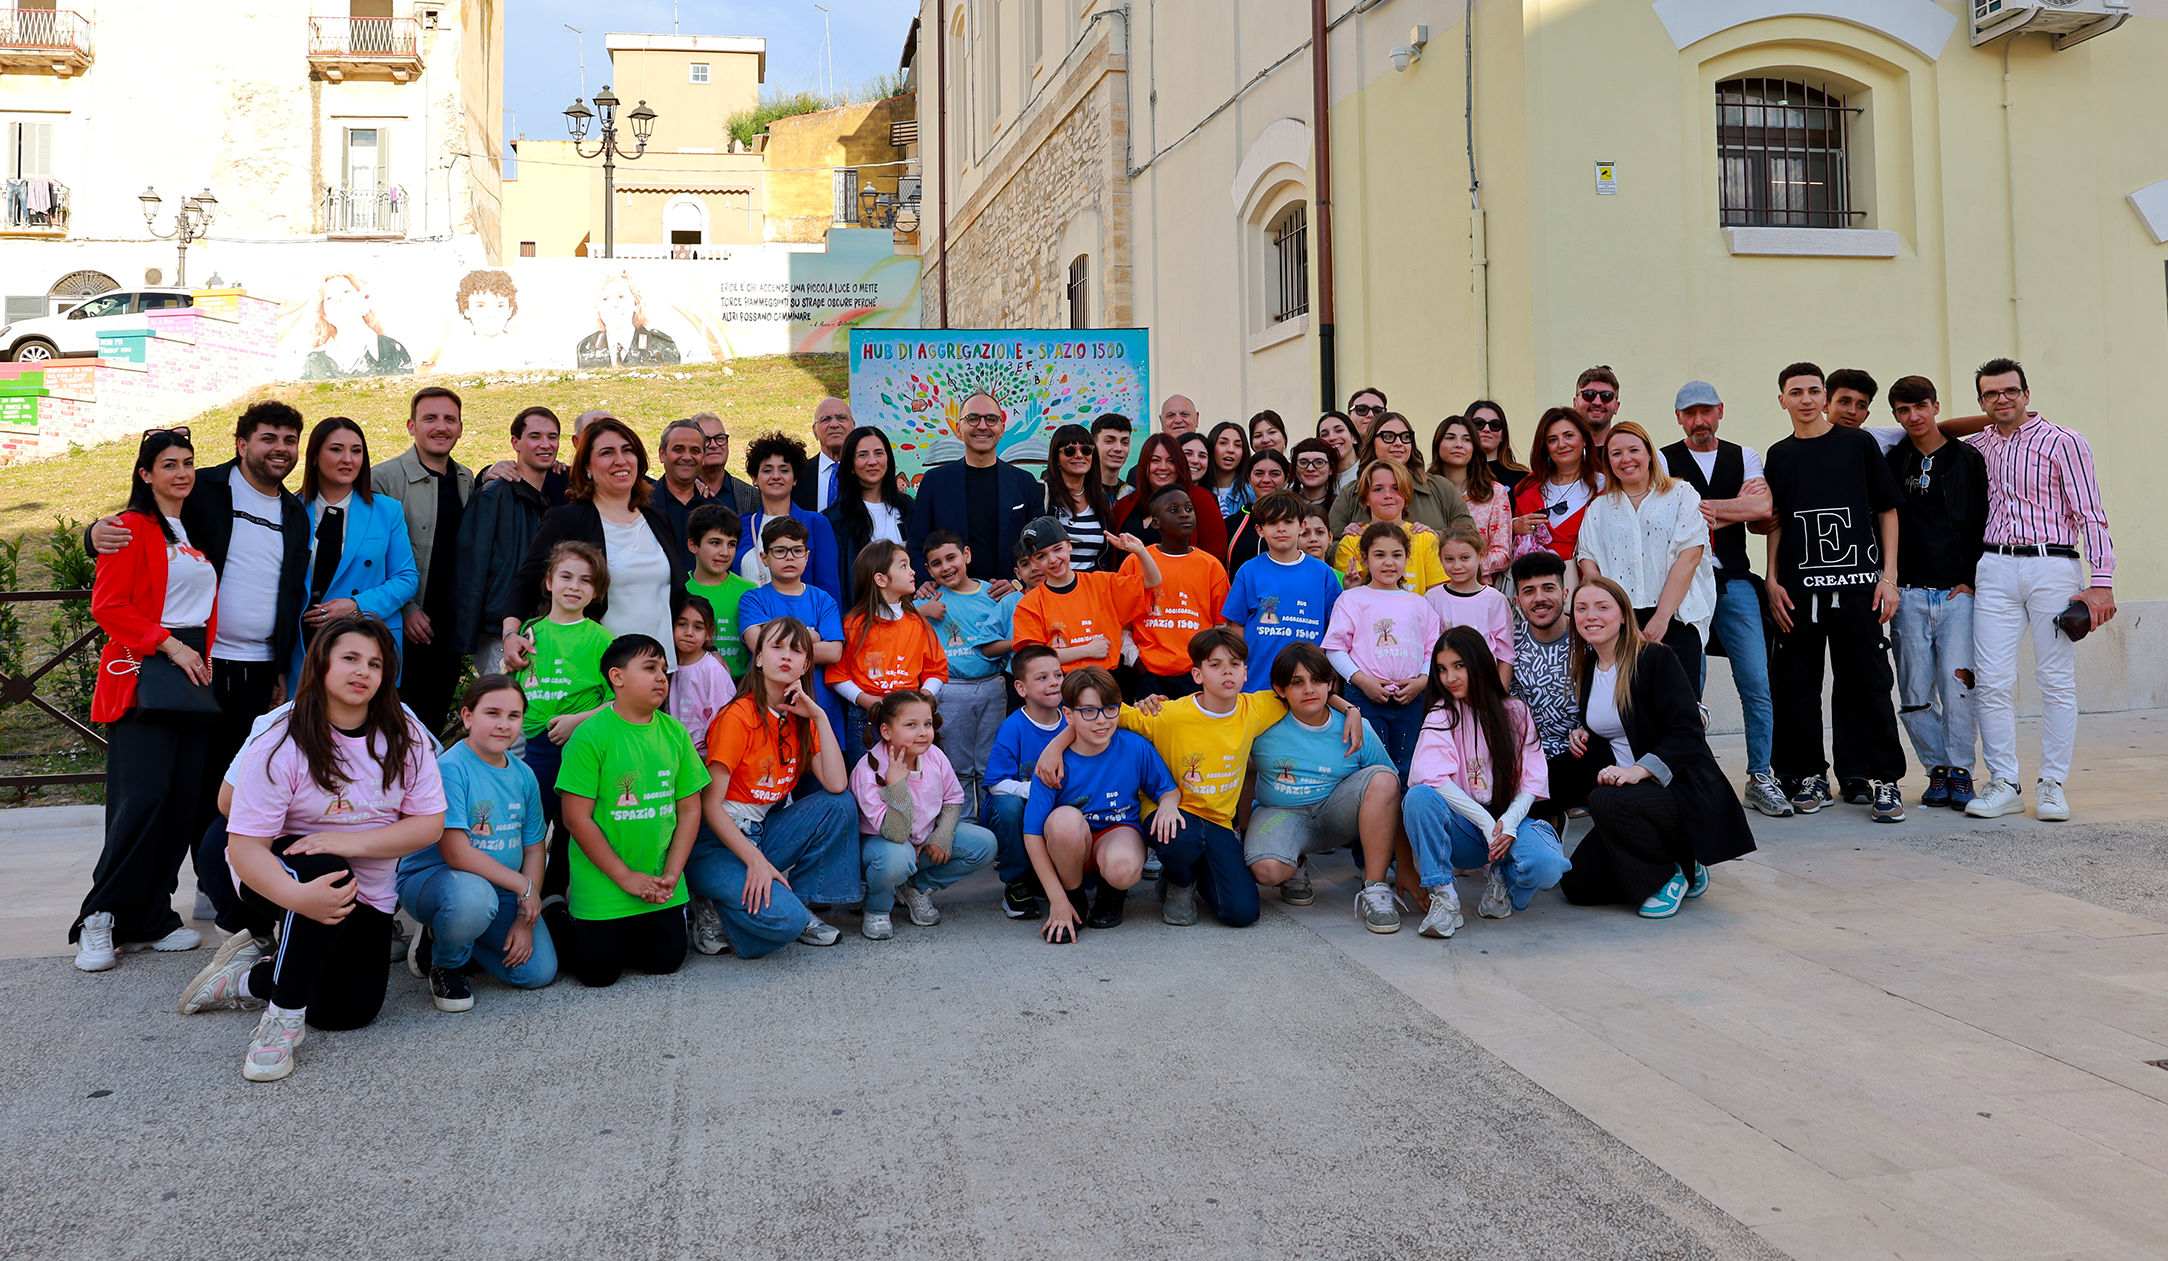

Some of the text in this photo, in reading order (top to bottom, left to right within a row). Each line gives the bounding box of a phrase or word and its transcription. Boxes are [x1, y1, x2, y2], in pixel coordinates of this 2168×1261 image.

[720, 283, 738, 293] EROE
[759, 283, 789, 293] ACCENDE
[790, 283, 806, 293] UNA
[806, 283, 834, 294] PICCOLA
[834, 283, 850, 294] LUCE
[852, 283, 858, 293] O
[858, 283, 879, 293] METTE
[720, 297, 742, 308] TORCE
[790, 297, 800, 307] SU
[801, 297, 826, 309] STRADE
[827, 297, 853, 308] OSCURE
[739, 311, 773, 322] POSSANO
[863, 342, 1125, 360] HUB DI AGGREGAZIONE SPAZIO 1500
[1034, 375, 1040, 385] B
[1013, 408, 1021, 417] A
